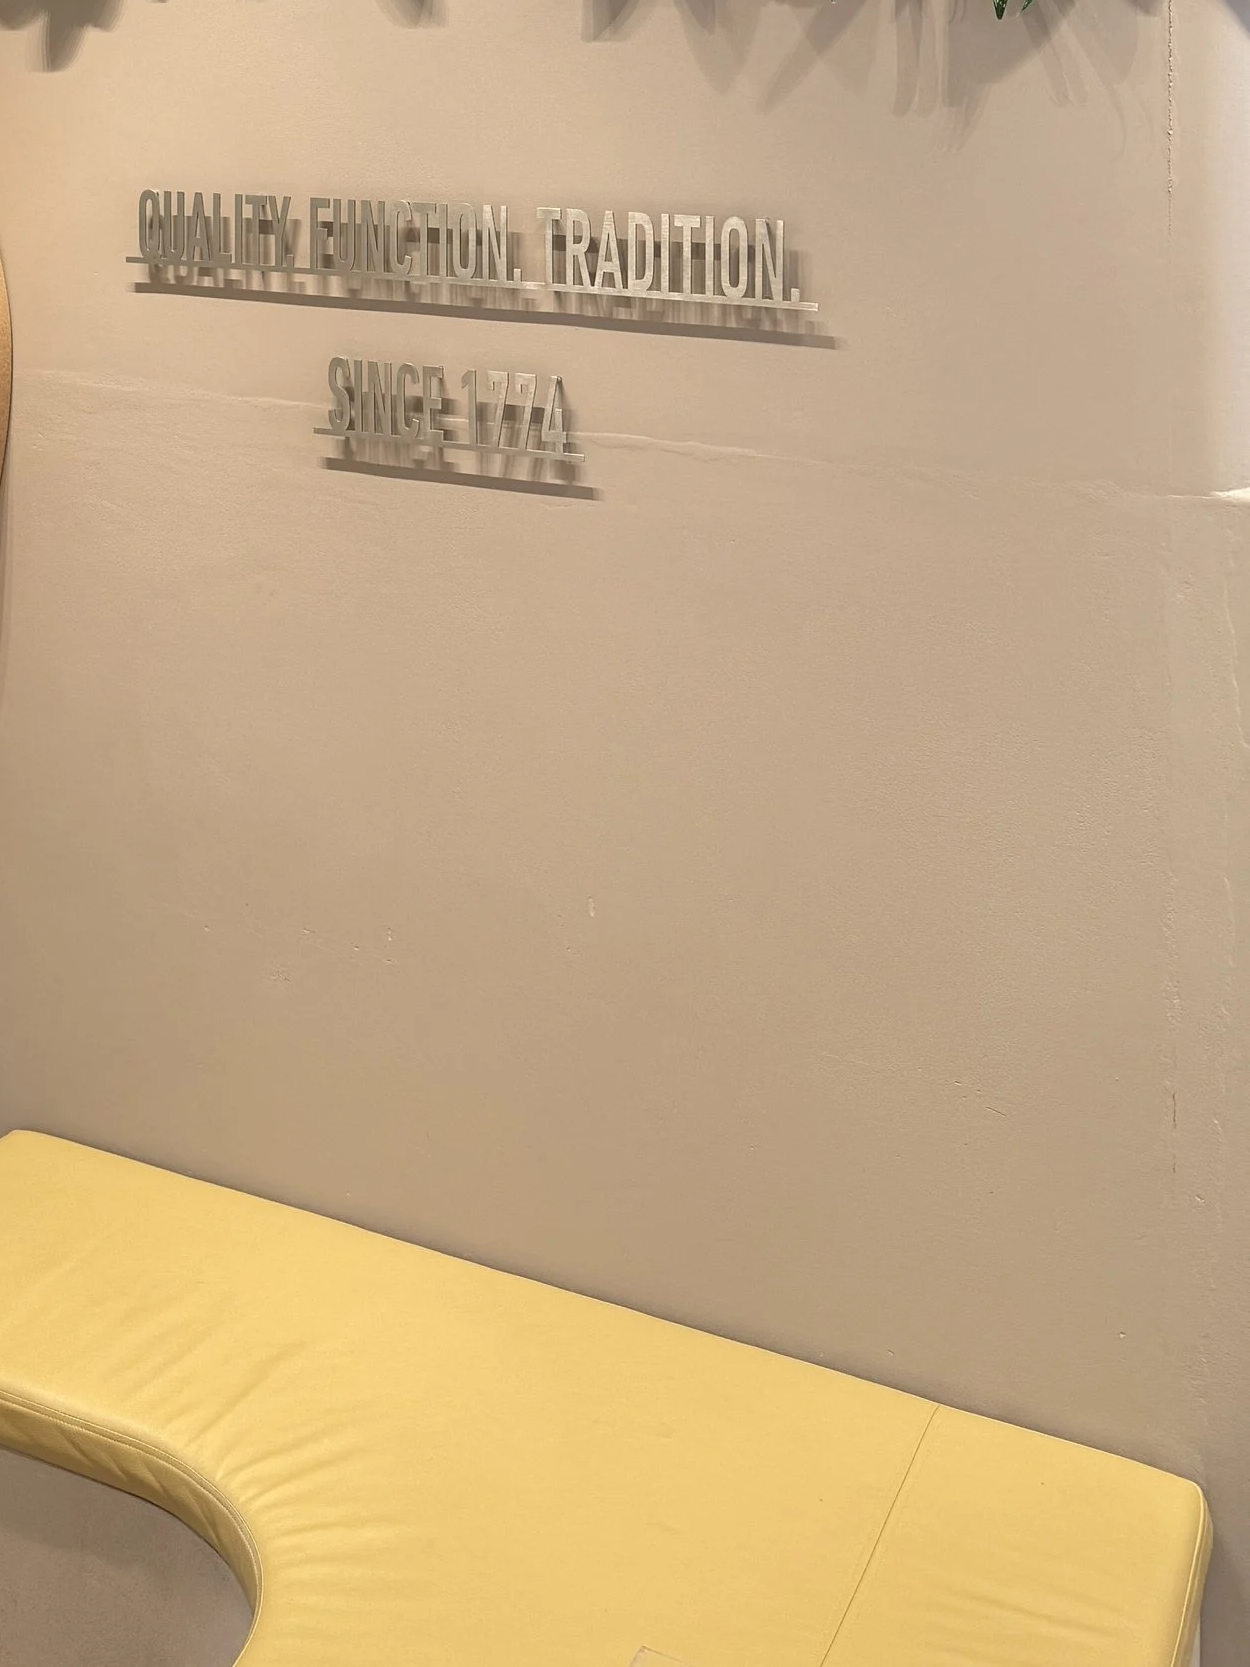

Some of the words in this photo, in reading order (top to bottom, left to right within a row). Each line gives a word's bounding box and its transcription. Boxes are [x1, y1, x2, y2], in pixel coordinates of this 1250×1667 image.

[138, 189, 295, 269] QUALITY.
[309, 197, 522, 283] FUNCTION.
[536, 207, 800, 303] TRADITION.
[328, 356, 444, 443] SINCE
[461, 368, 567, 455] 1774
